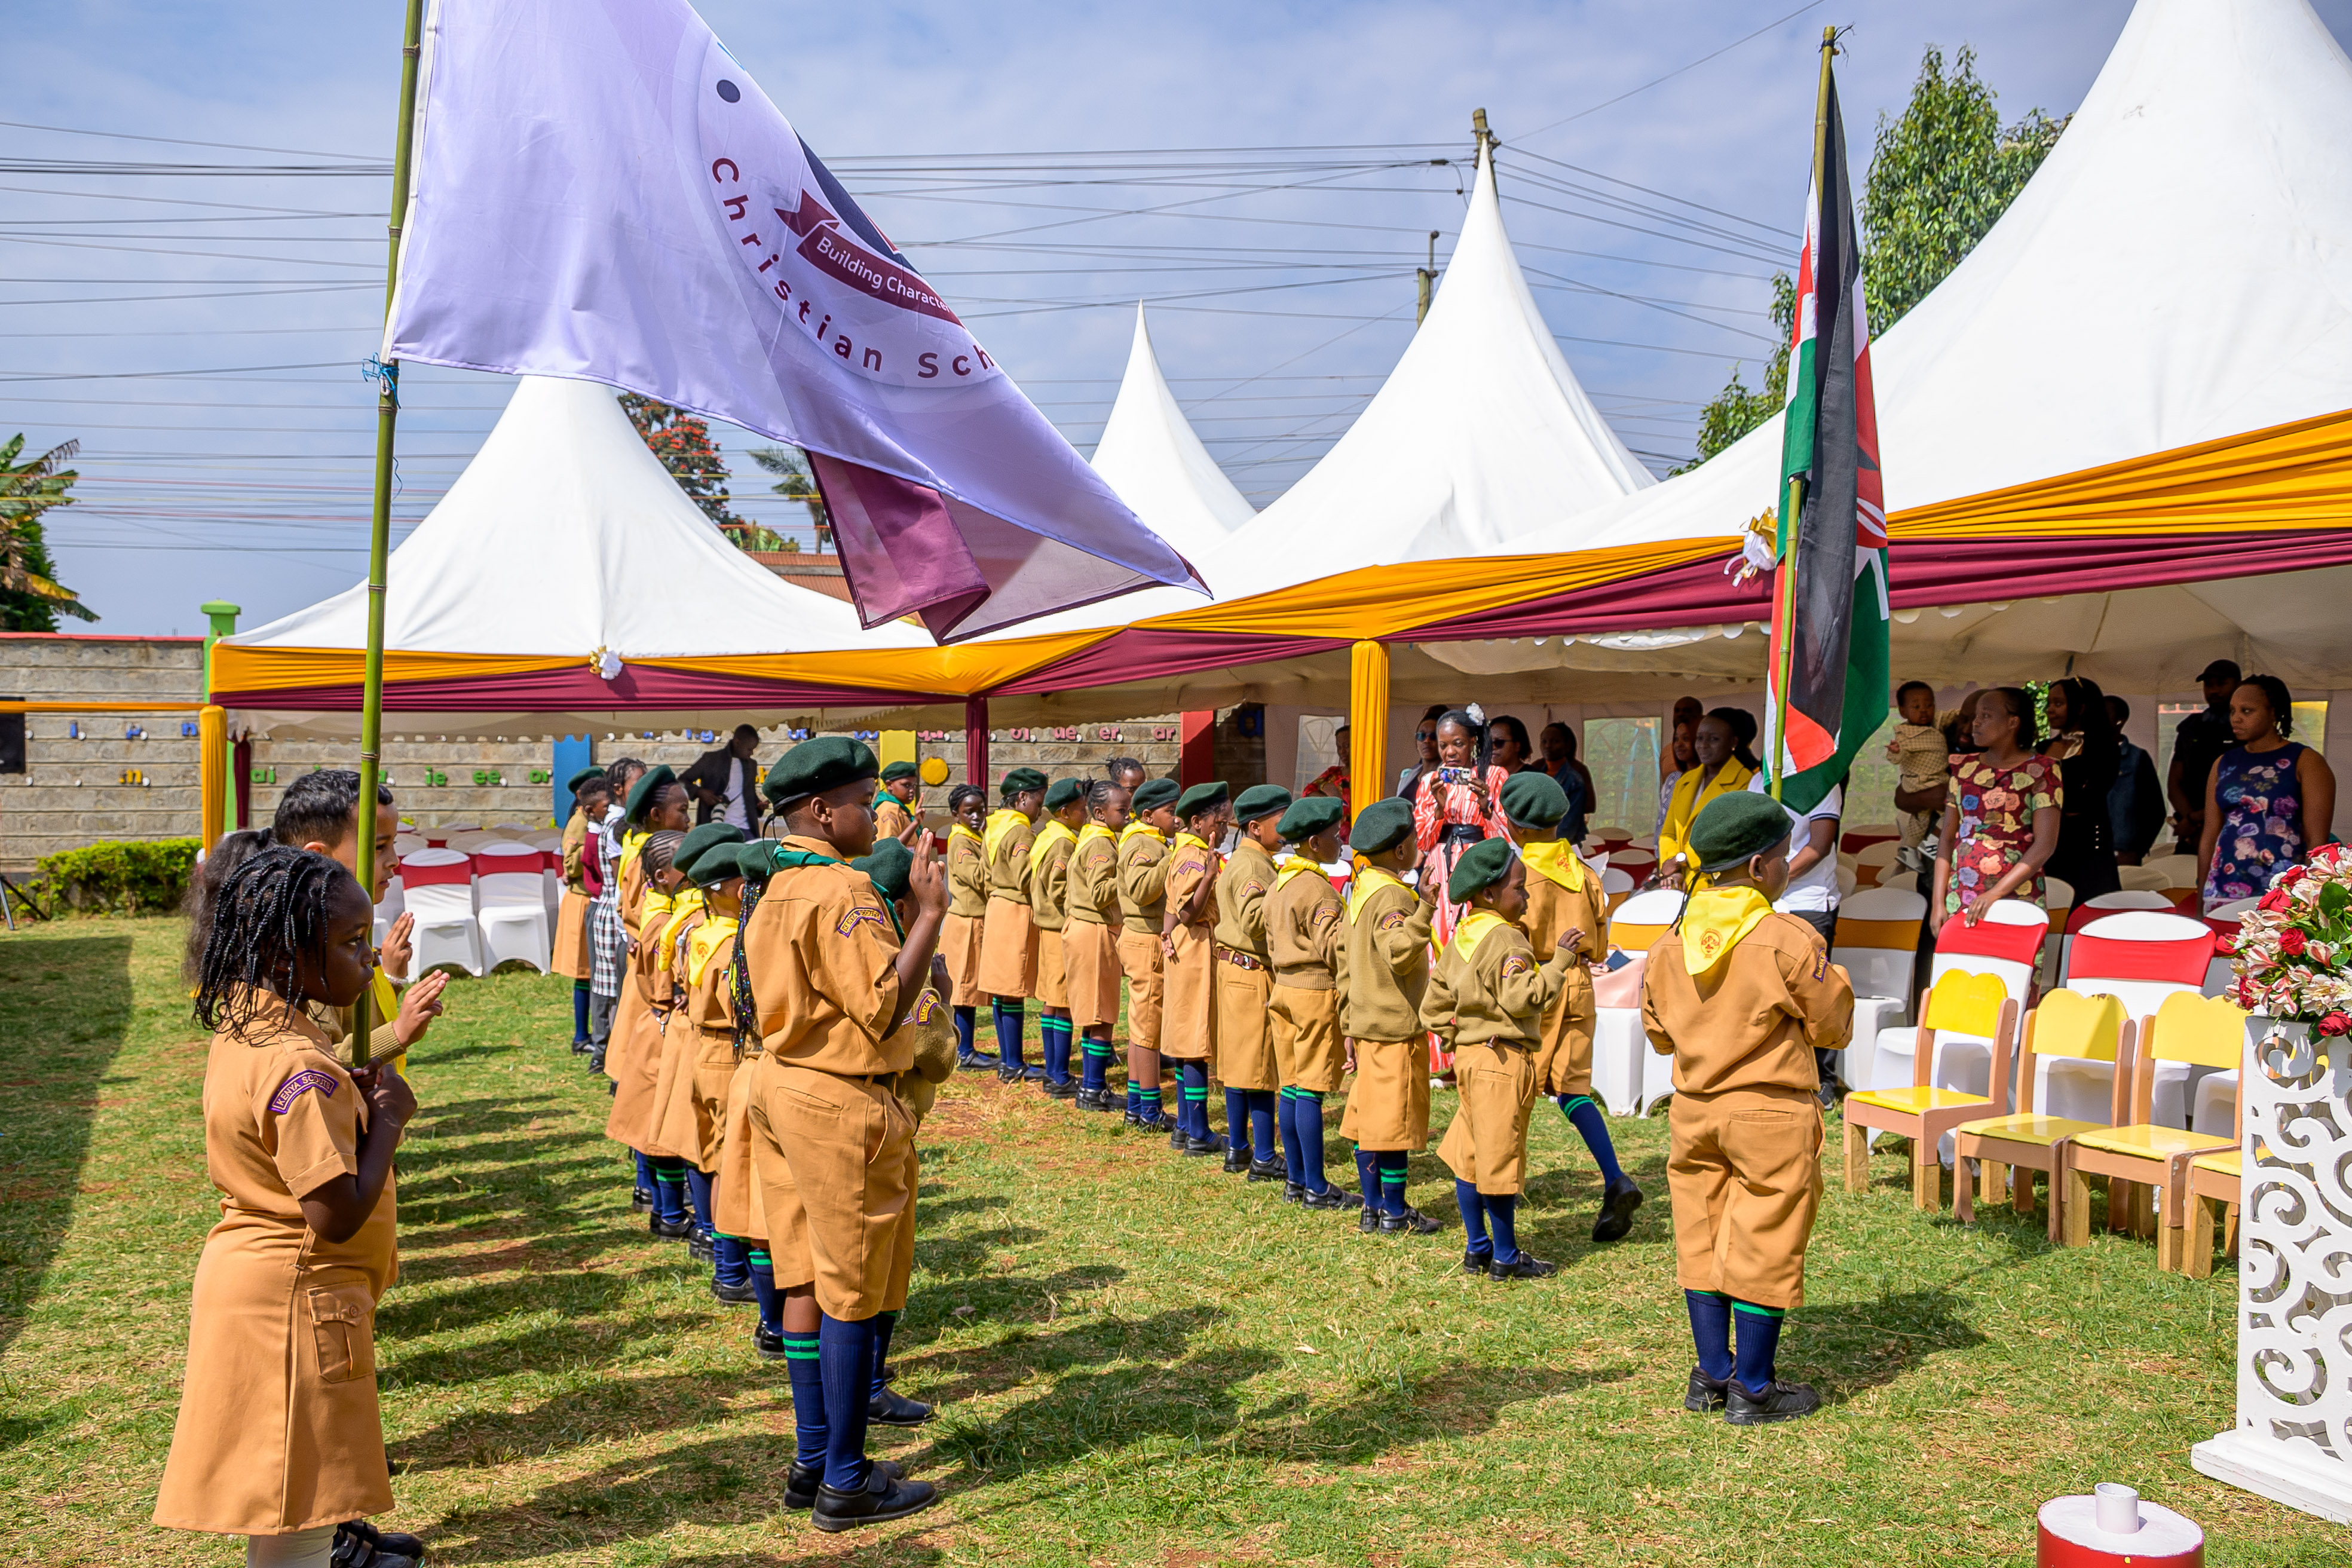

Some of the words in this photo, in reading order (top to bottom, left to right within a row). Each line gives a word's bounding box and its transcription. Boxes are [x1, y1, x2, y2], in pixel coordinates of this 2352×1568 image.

[712, 158, 883, 372] Christian
[816, 236, 883, 289] Building
[1153, 727, 1175, 740] ar
[425, 765, 446, 786] ie
[277, 1082, 301, 1106] KENYA
[302, 1075, 330, 1089] SCOUTS
